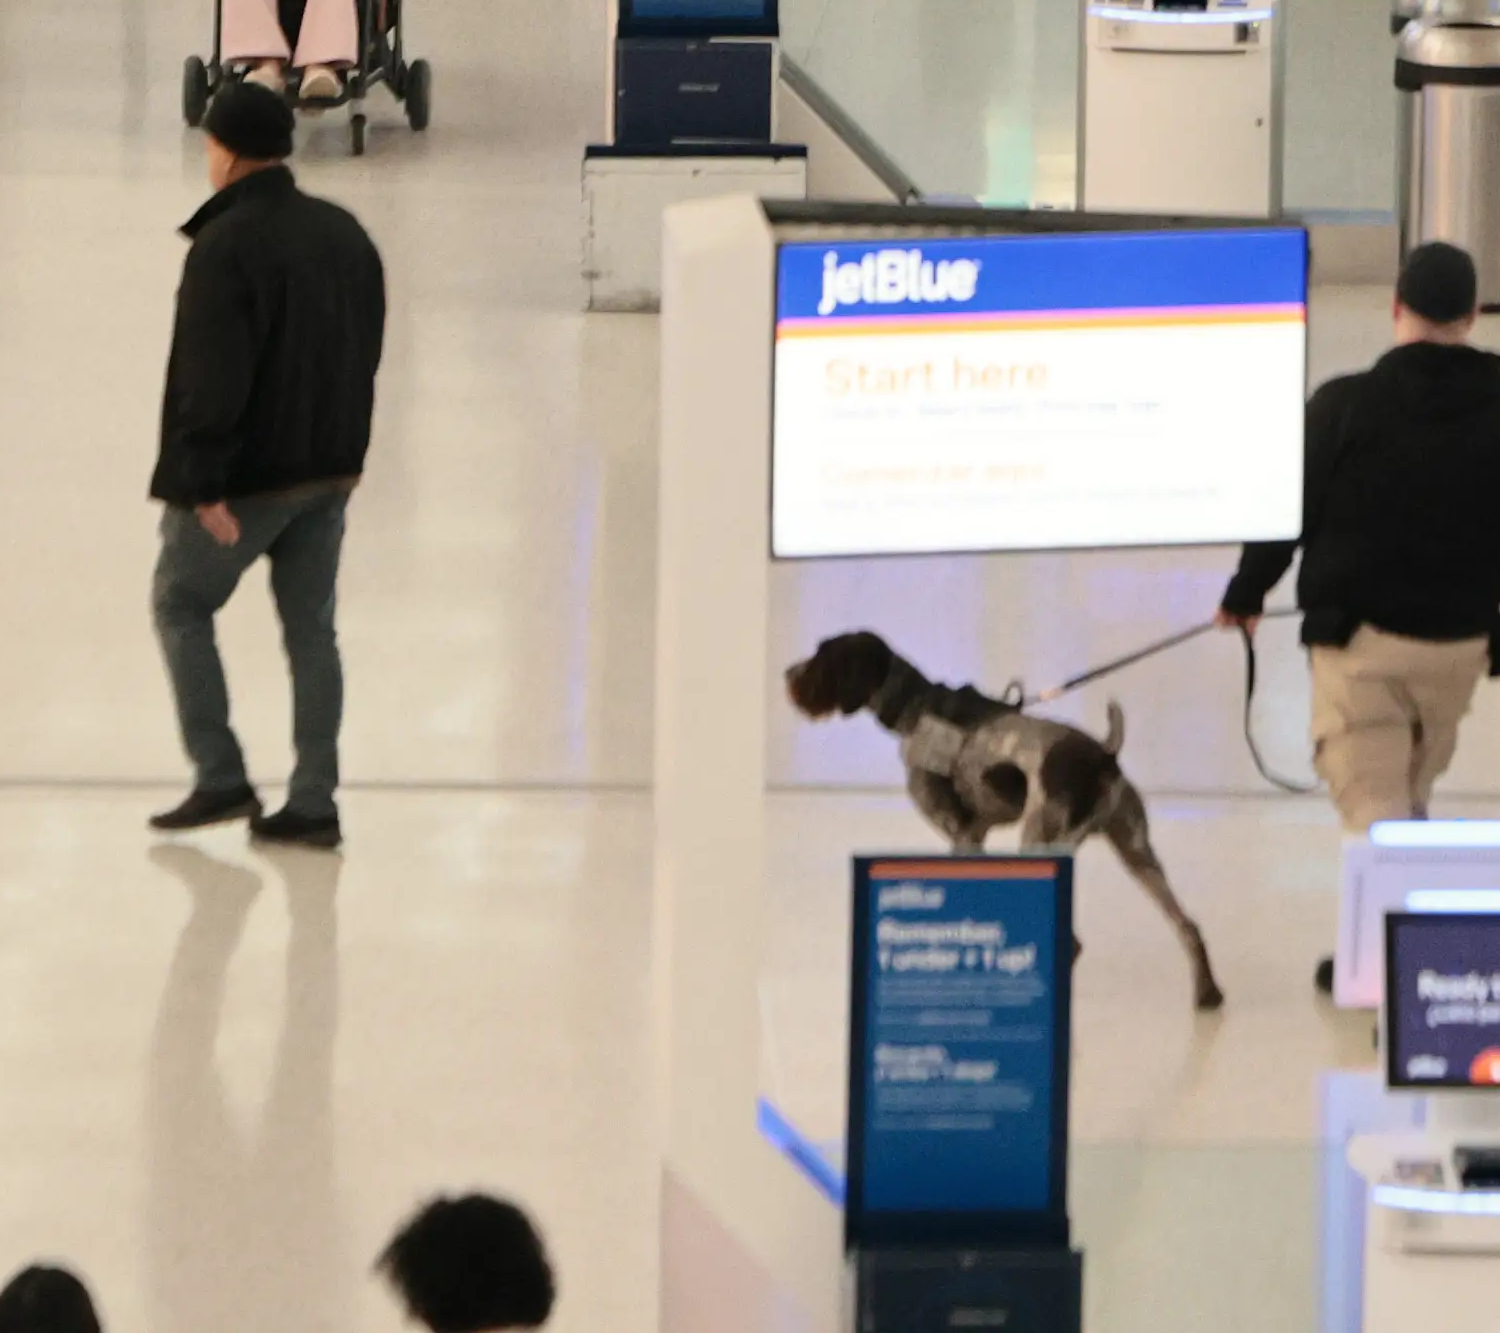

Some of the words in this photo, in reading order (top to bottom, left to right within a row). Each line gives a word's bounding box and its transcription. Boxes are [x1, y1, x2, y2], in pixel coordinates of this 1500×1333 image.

[816, 248, 983, 316] jetBlue
[824, 357, 934, 397] Start
[952, 355, 1051, 391] here
